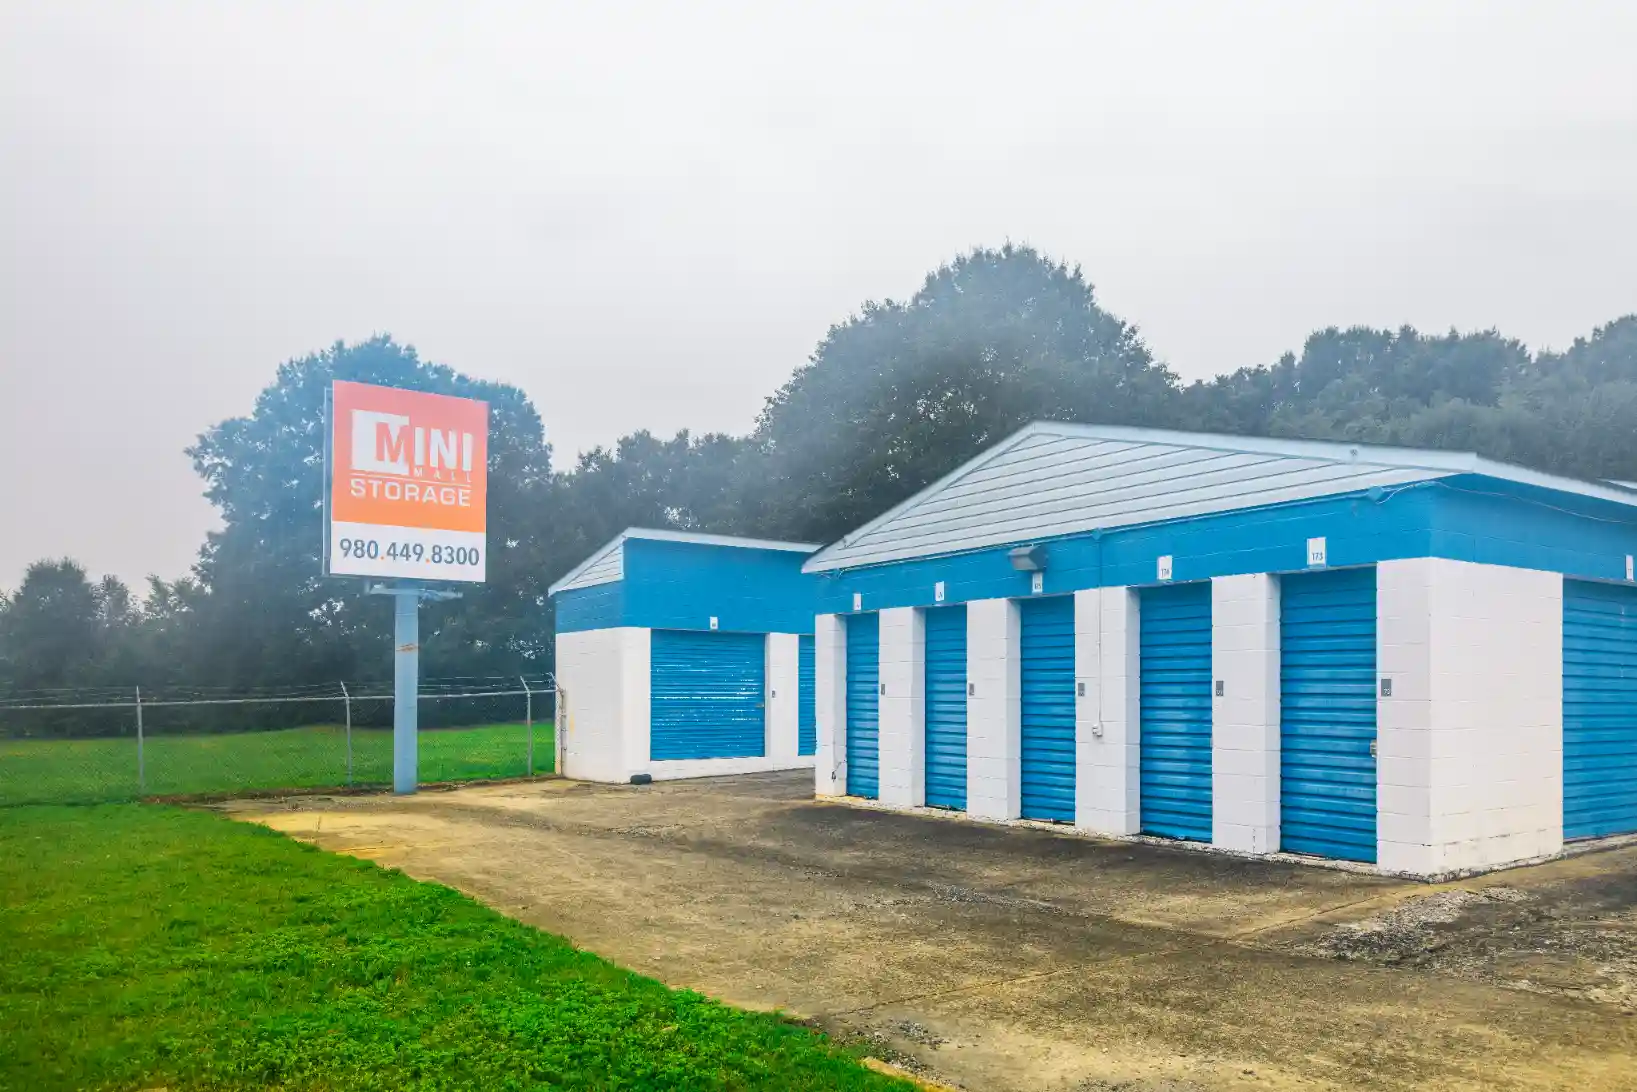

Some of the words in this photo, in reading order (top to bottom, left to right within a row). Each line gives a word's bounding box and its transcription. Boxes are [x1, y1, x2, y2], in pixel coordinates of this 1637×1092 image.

[374, 419, 473, 472] MINI
[414, 467, 472, 483] MALL
[350, 478, 472, 507] STORAGE
[339, 538, 480, 566] 980.449.8300
